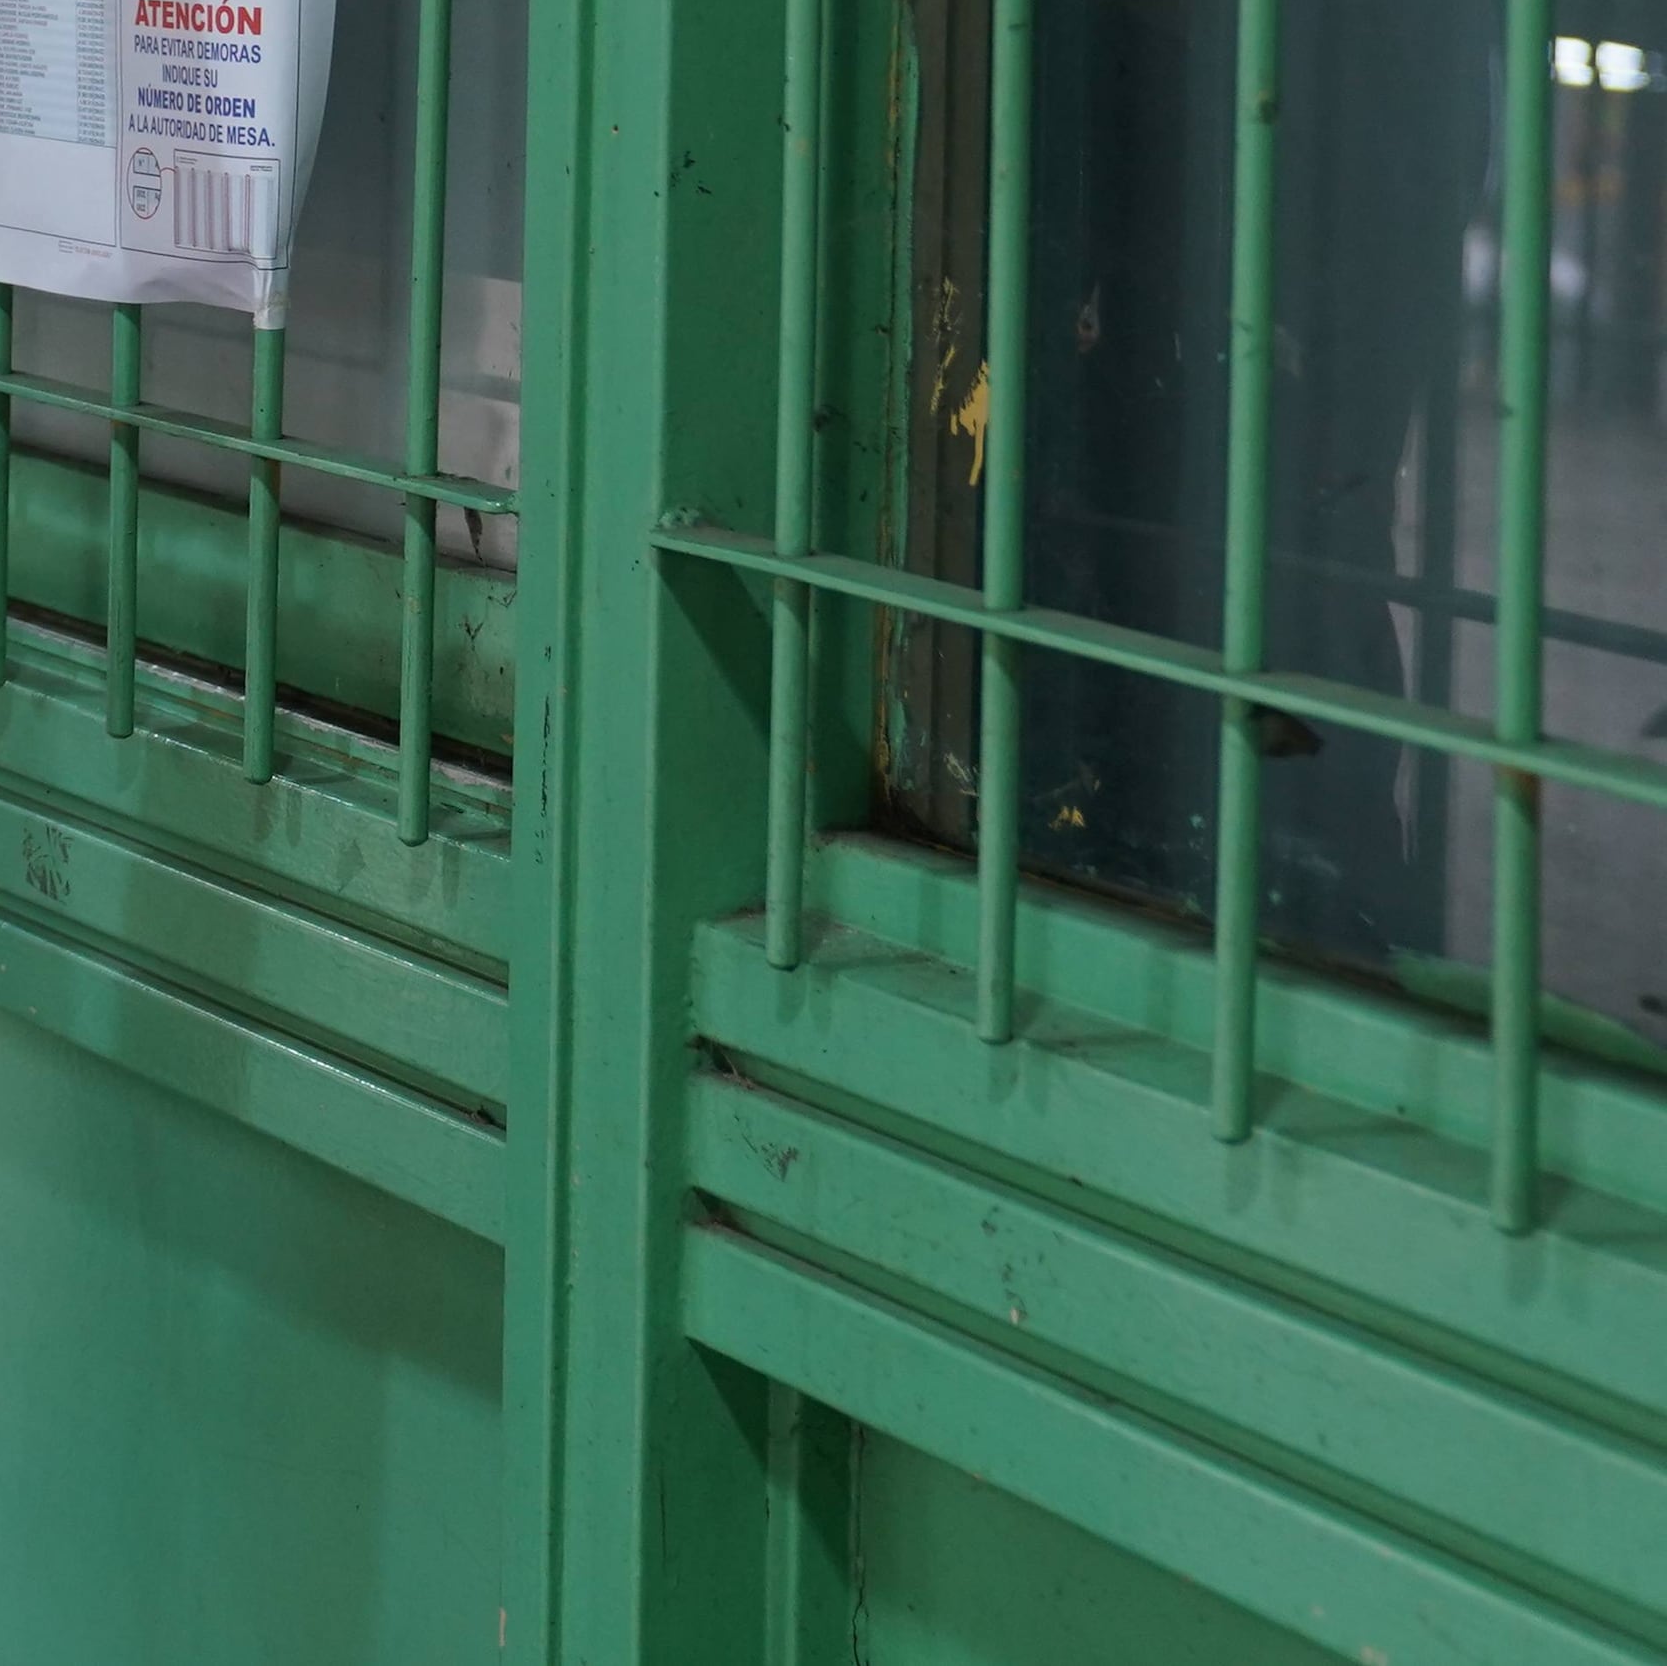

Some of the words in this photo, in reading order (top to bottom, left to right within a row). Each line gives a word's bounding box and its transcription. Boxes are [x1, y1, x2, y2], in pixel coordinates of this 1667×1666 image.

[134, 34, 159, 55] PARA
[162, 38, 195, 59] EVITAR
[197, 41, 262, 64] DEMORAS
[162, 63, 201, 87] INDIQUE
[203, 68, 218, 88] SU
[138, 84, 184, 111] NÚMERO
[187, 93, 202, 114] DE
[205, 95, 256, 119] ORDEN
[128, 113, 136, 132] A
[137, 115, 149, 133] LA
[151, 116, 206, 141] AUTORIDAD
[209, 124, 223, 144] DE
[227, 125, 276, 148] MESA.
